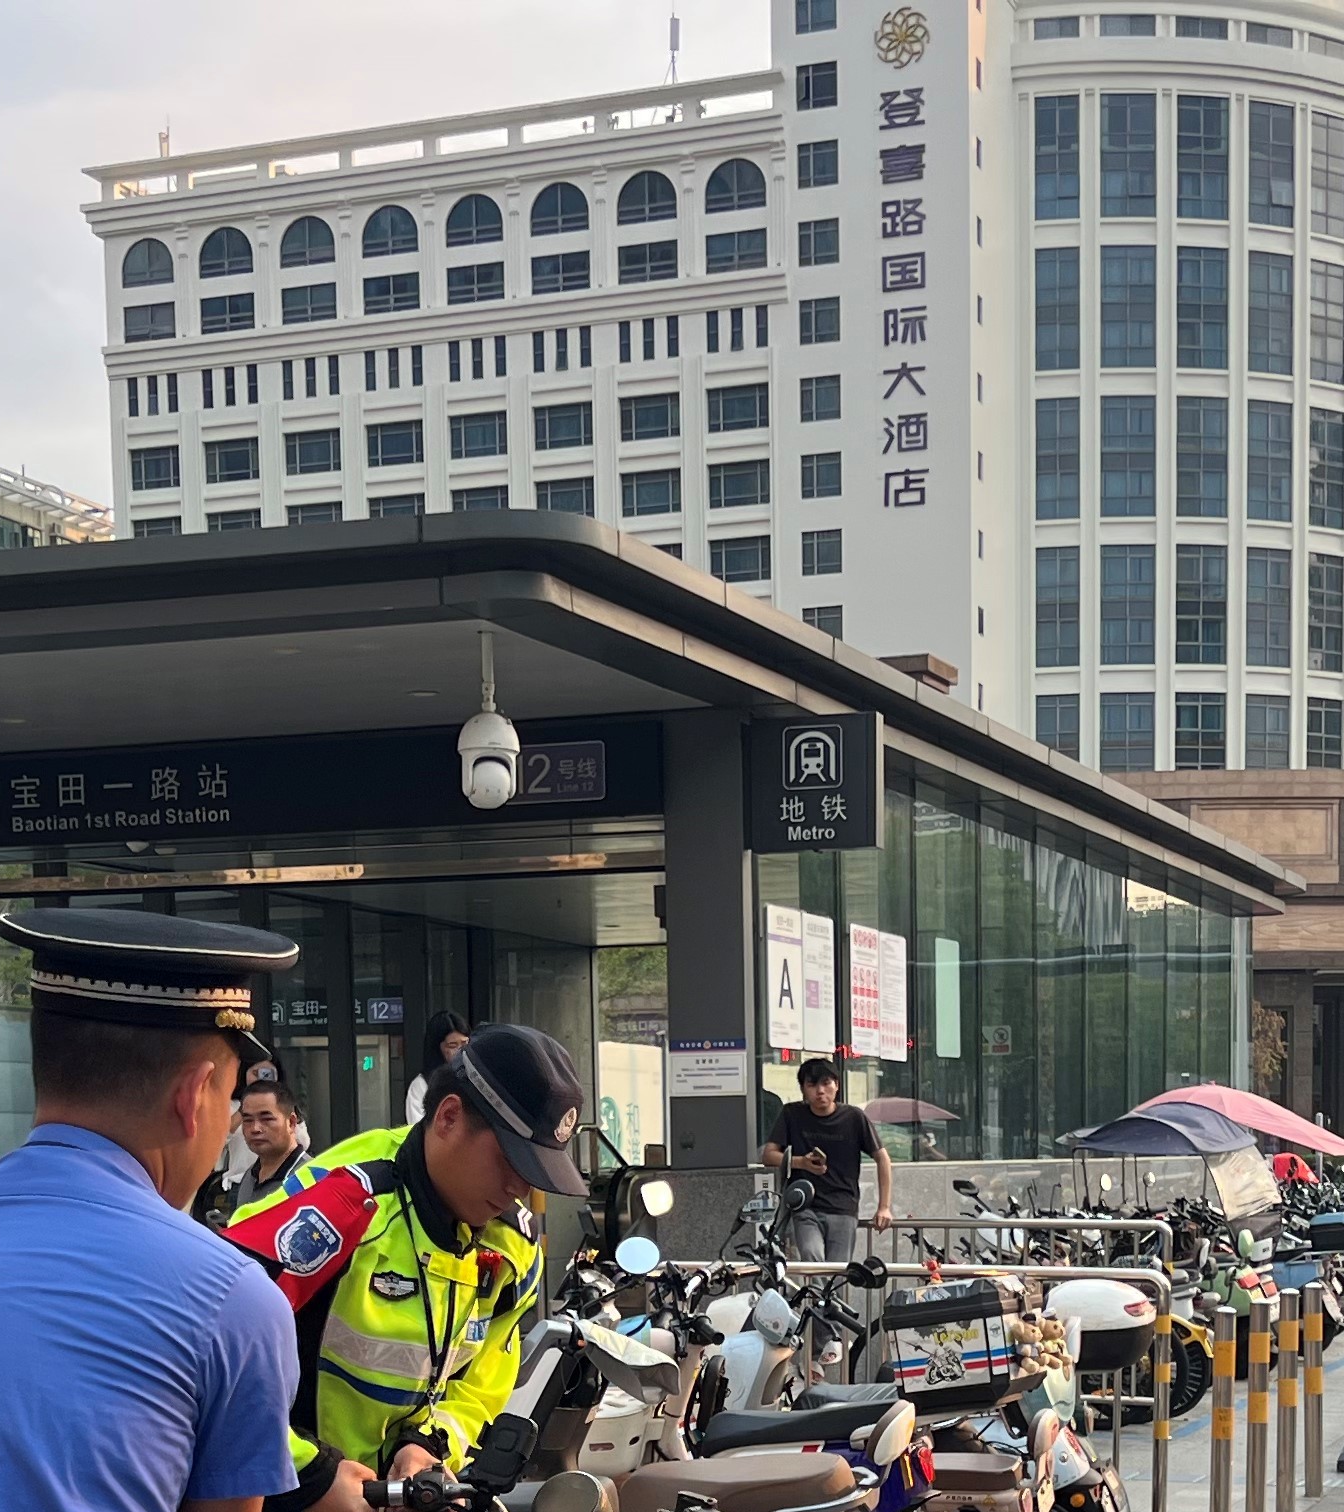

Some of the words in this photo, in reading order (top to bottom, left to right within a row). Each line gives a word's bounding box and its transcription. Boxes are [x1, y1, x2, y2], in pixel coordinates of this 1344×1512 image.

[878, 86, 930, 508] 登喜路国际大酒店
[557, 757, 597, 780] 号线
[10, 762, 229, 810] 宝田一路站
[12, 814, 79, 833] Baotian
[85, 812, 110, 829] 1st
[115, 809, 160, 827] Road
[165, 806, 230, 825] Station
[780, 793, 847, 824] 地铁
[787, 825, 836, 842] Metro
[779, 958, 794, 1010] A
[370, 1000, 389, 1020] 12
